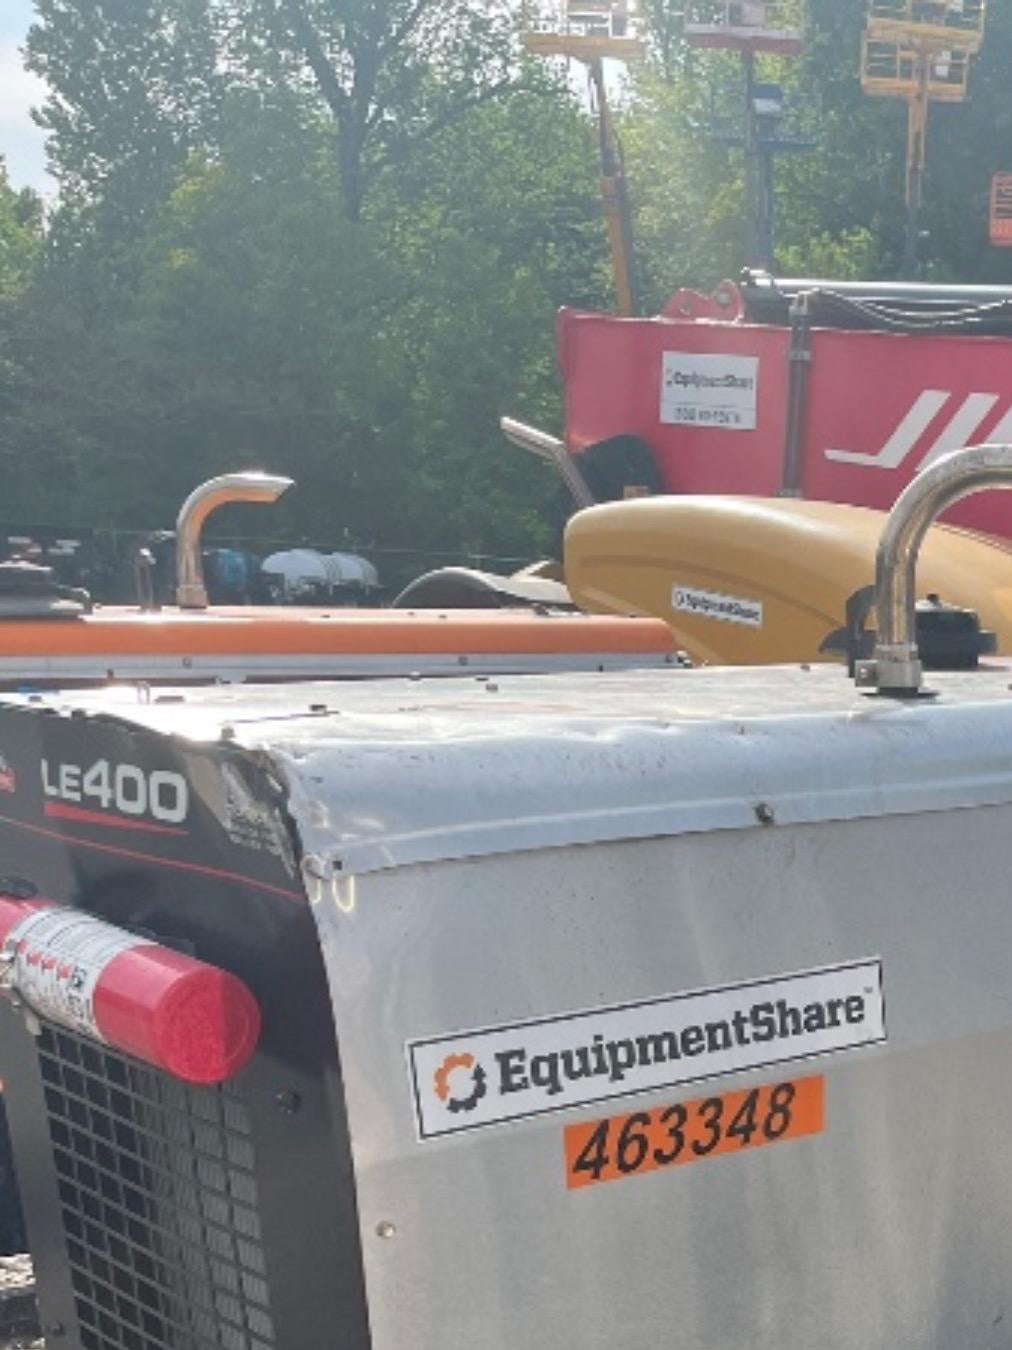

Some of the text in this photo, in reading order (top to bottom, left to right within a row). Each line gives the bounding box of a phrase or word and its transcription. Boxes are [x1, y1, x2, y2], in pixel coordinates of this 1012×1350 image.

[41, 757, 189, 823] LE400
[494, 993, 866, 1096] EquipmentShare
[572, 1081, 796, 1180] 463348
